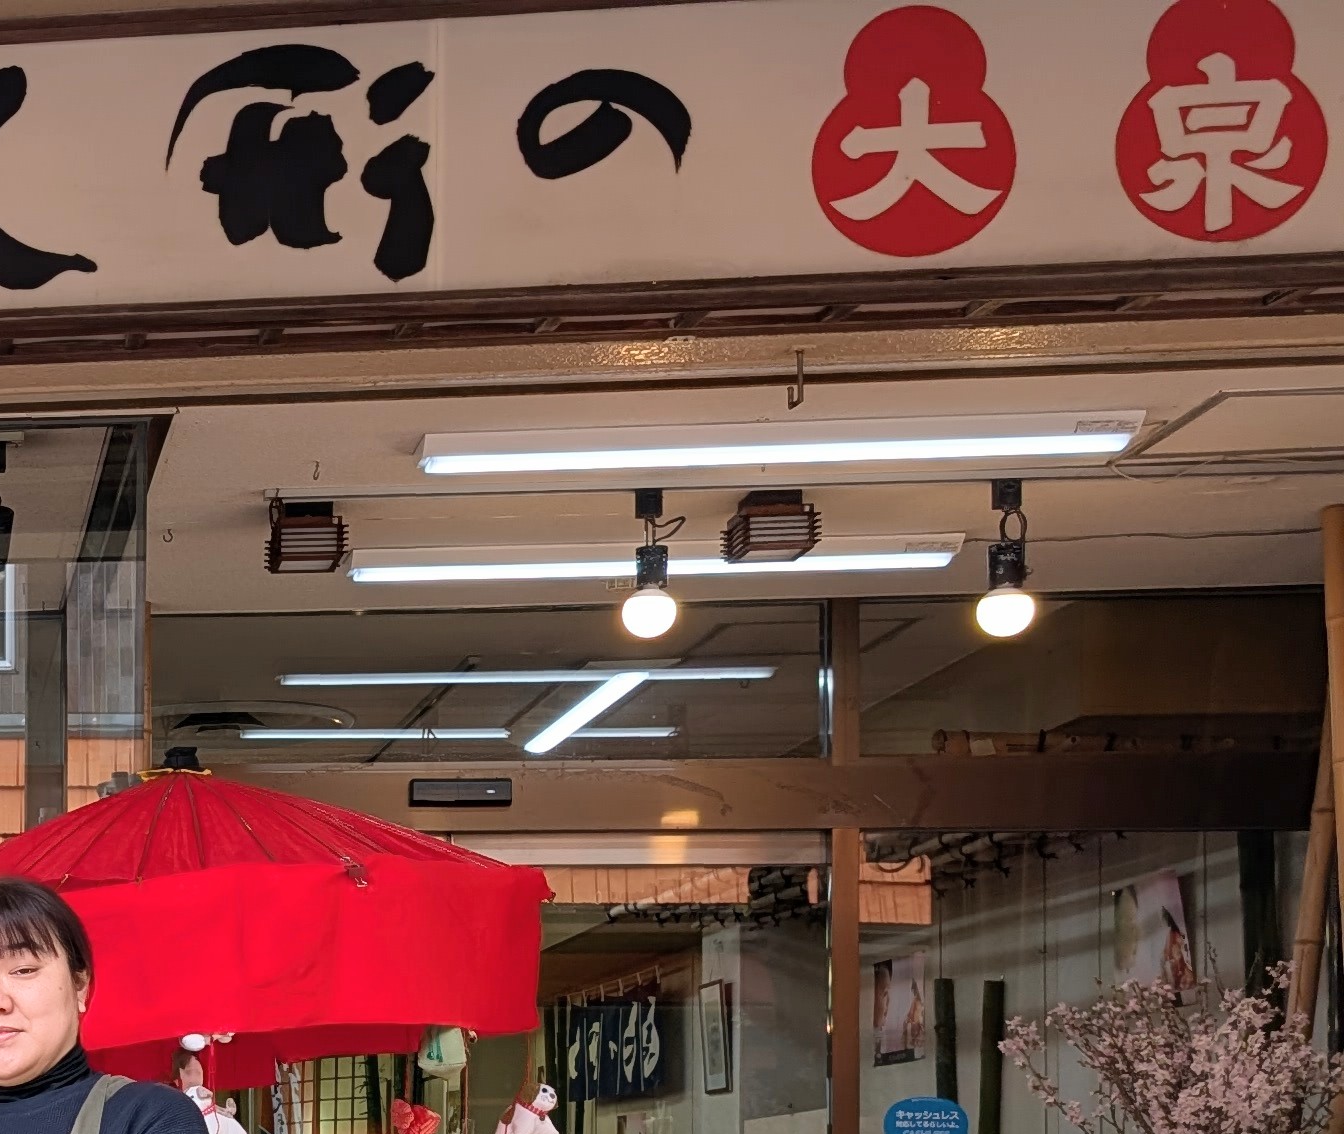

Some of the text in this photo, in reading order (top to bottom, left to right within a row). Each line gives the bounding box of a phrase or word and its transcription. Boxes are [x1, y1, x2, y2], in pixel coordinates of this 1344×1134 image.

[895, 1109, 960, 1120] キャッシュレス
[895, 1120, 960, 1129] 対応してるらしいよ。
